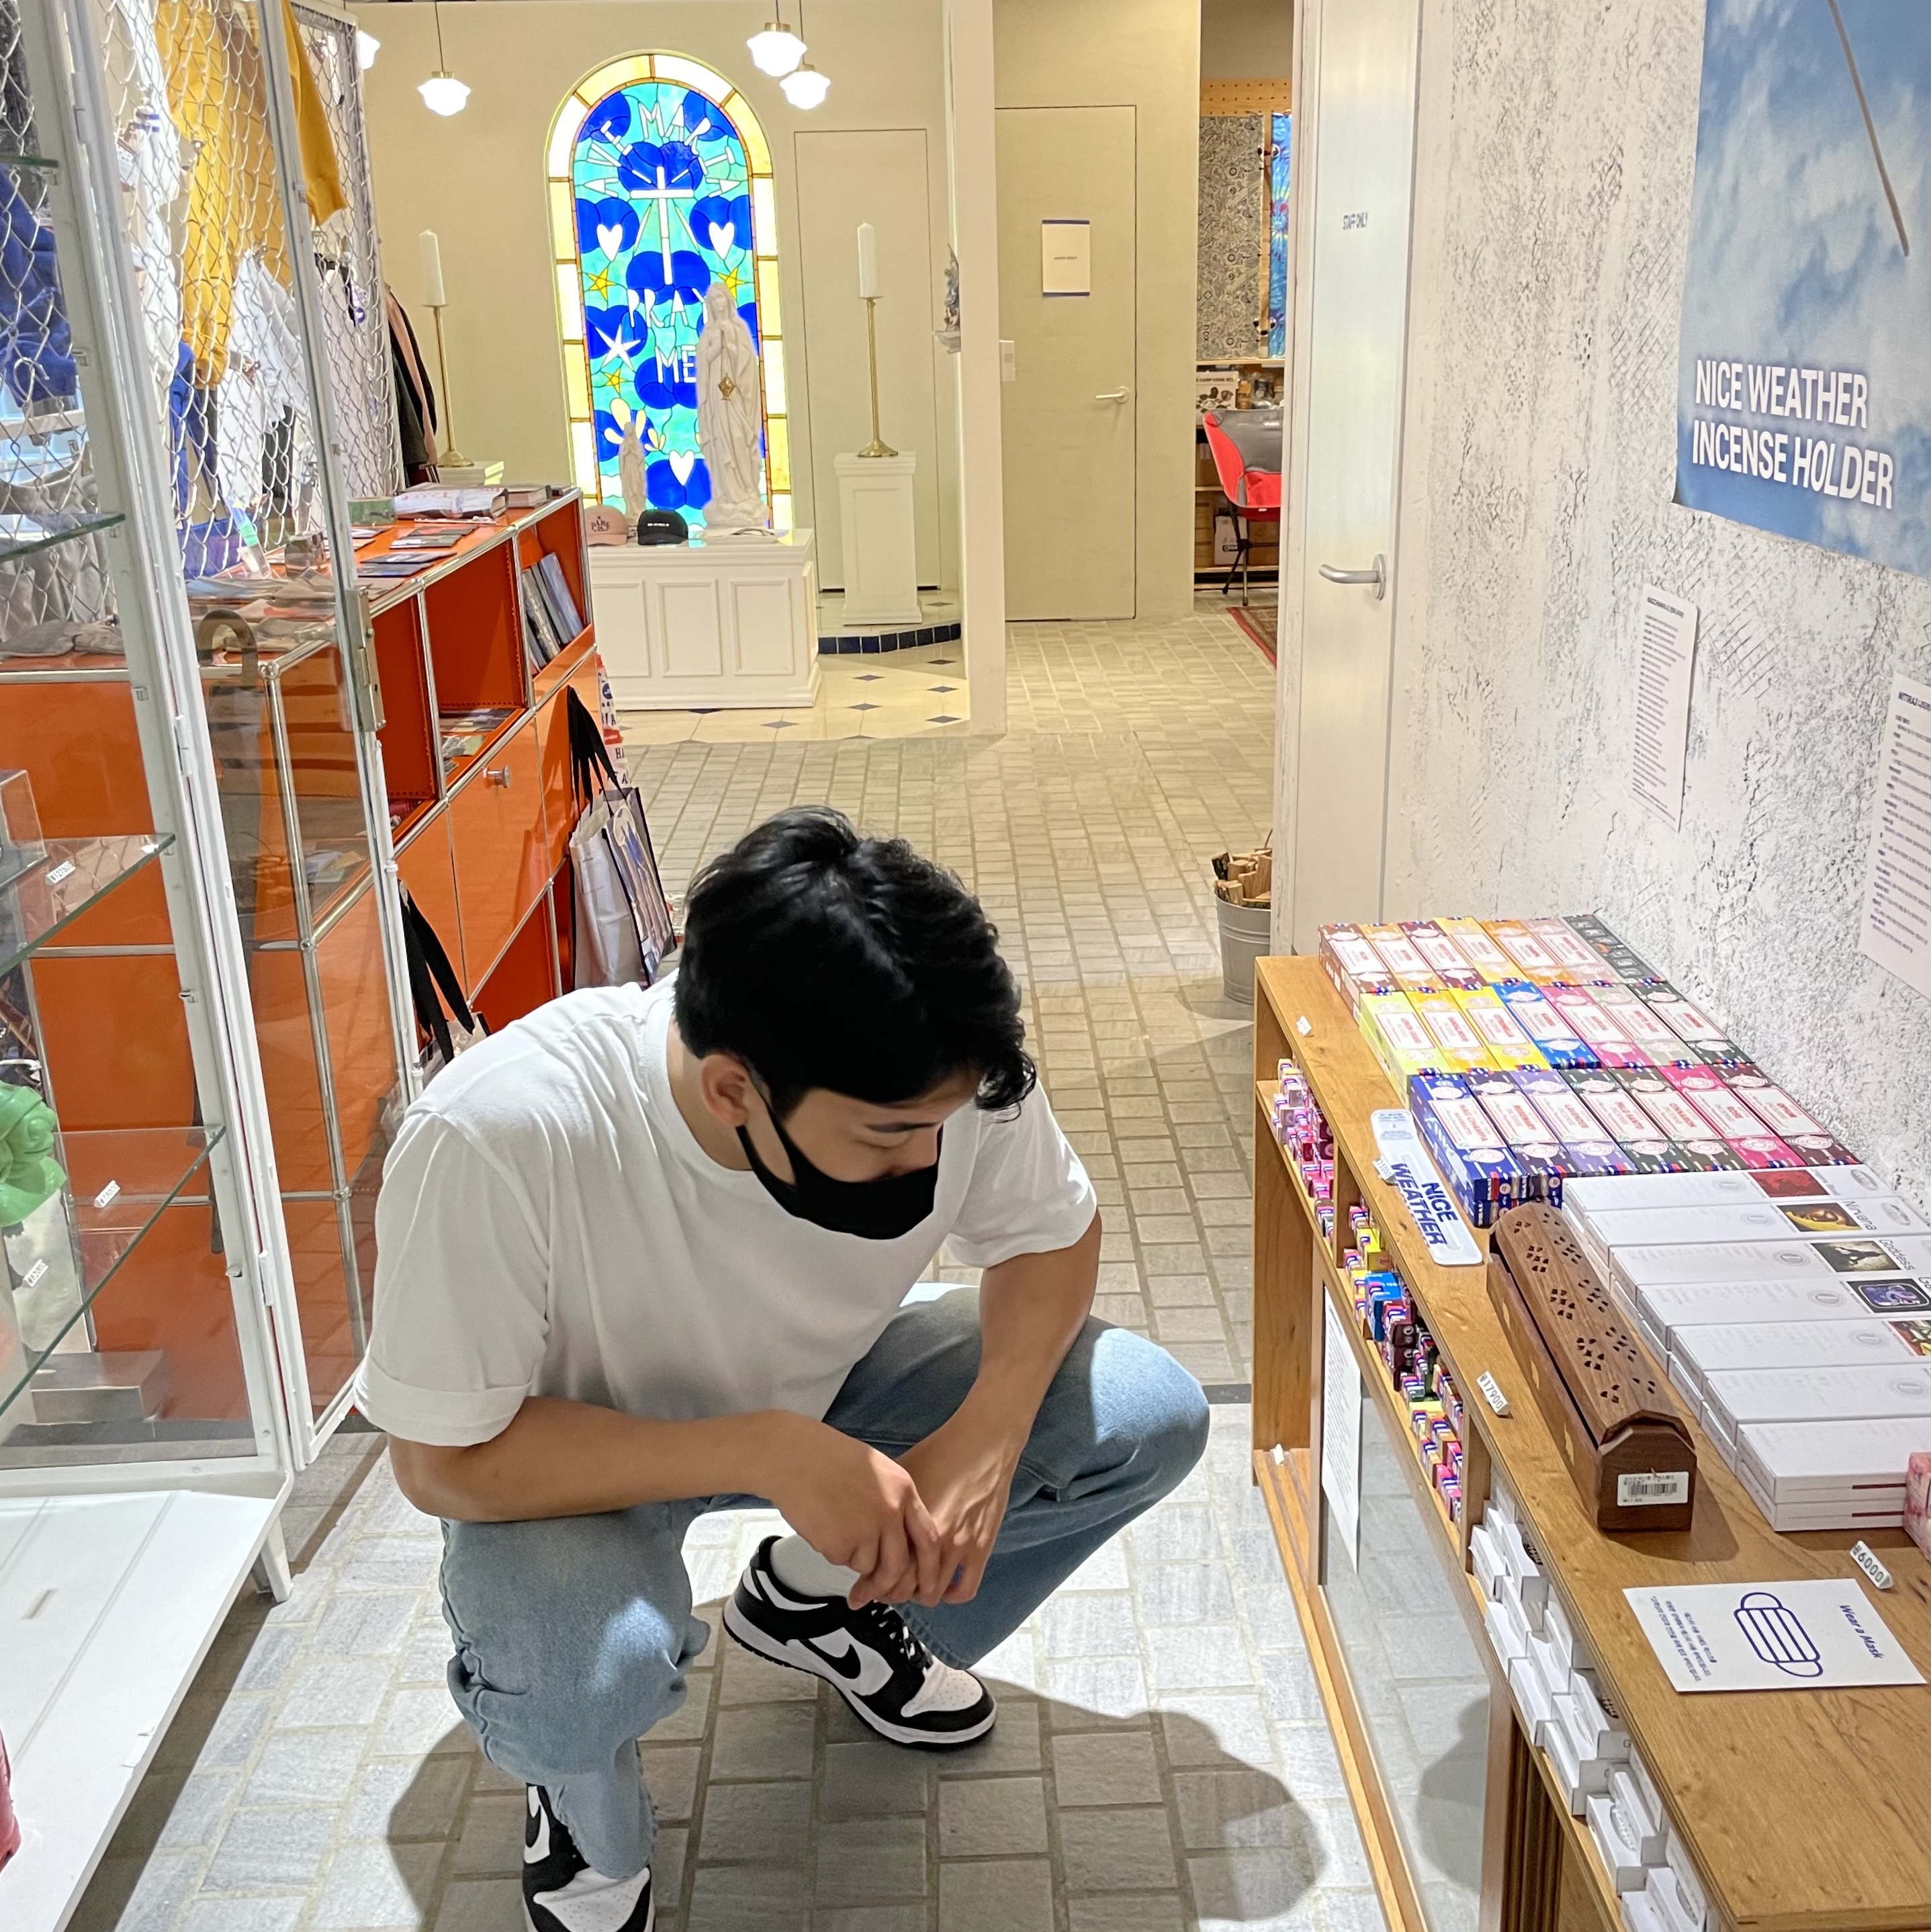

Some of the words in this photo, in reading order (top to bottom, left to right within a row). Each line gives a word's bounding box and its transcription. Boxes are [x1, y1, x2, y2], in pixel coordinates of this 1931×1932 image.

[1695, 359, 1743, 410] NICE
[1748, 364, 1867, 429] WEATHER
[1693, 420, 1788, 483] INCENSE
[1793, 436, 1894, 509] HOLDER
[1458, 1104, 1472, 1115] NAG
[1467, 1117, 1488, 1141] CHAMPA
[1512, 1105, 1537, 1130] ROSEMARY
[1563, 1104, 1589, 1128] LAVENDER
[1614, 1102, 1631, 1112] PALO
[1625, 1114, 1645, 1129] SANTO
[1668, 1103, 1697, 1127] CINNAMON
[1725, 1106, 1744, 1118] ROSE
[1775, 1103, 1797, 1117] OPIUM
[1391, 1163, 1447, 1245] WEATHER
[1421, 1182, 1458, 1222] NICE
[1844, 1200, 1877, 1231] Nirvana
[1879, 1239, 1915, 1271] Goddess
[1858, 1552, 1884, 1583] 6000
[1840, 1605, 1862, 1628] Wear
[1859, 1635, 1883, 1659] Mask
